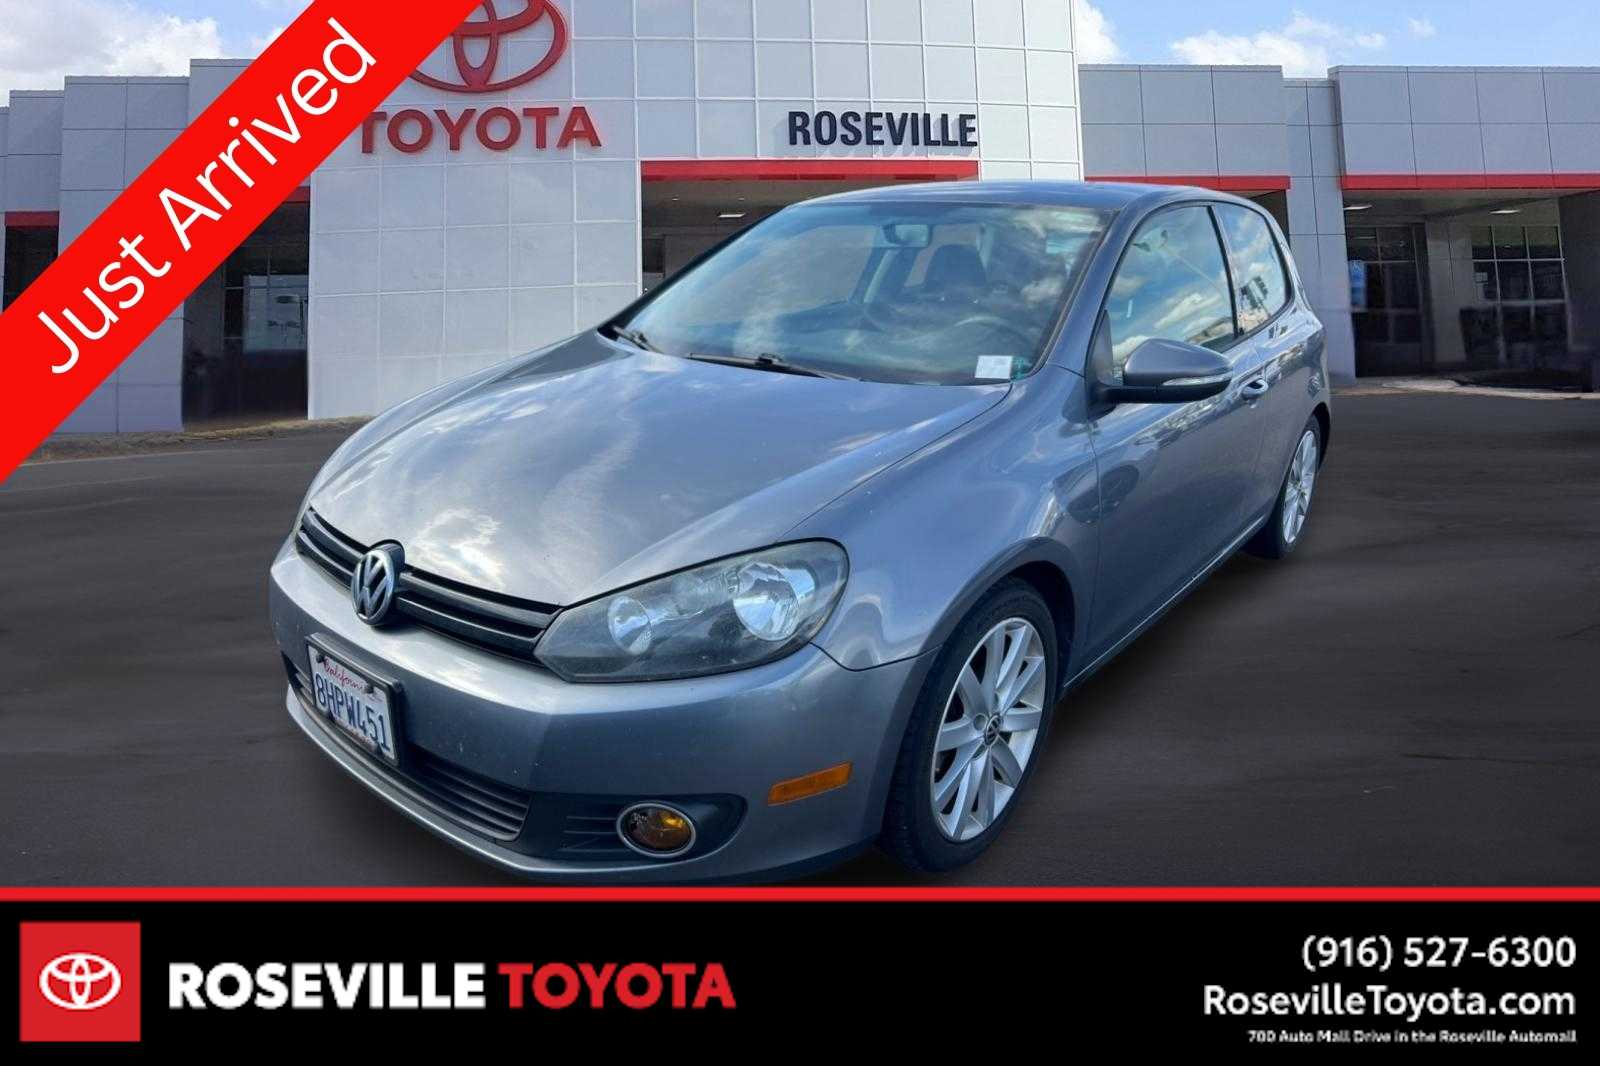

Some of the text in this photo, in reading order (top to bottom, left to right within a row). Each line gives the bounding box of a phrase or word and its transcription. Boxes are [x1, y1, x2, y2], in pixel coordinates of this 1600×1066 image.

[361, 106, 602, 154] TOYOTA
[788, 111, 978, 147] ROSEVILLE
[315, 672, 391, 751] 8HPW451
